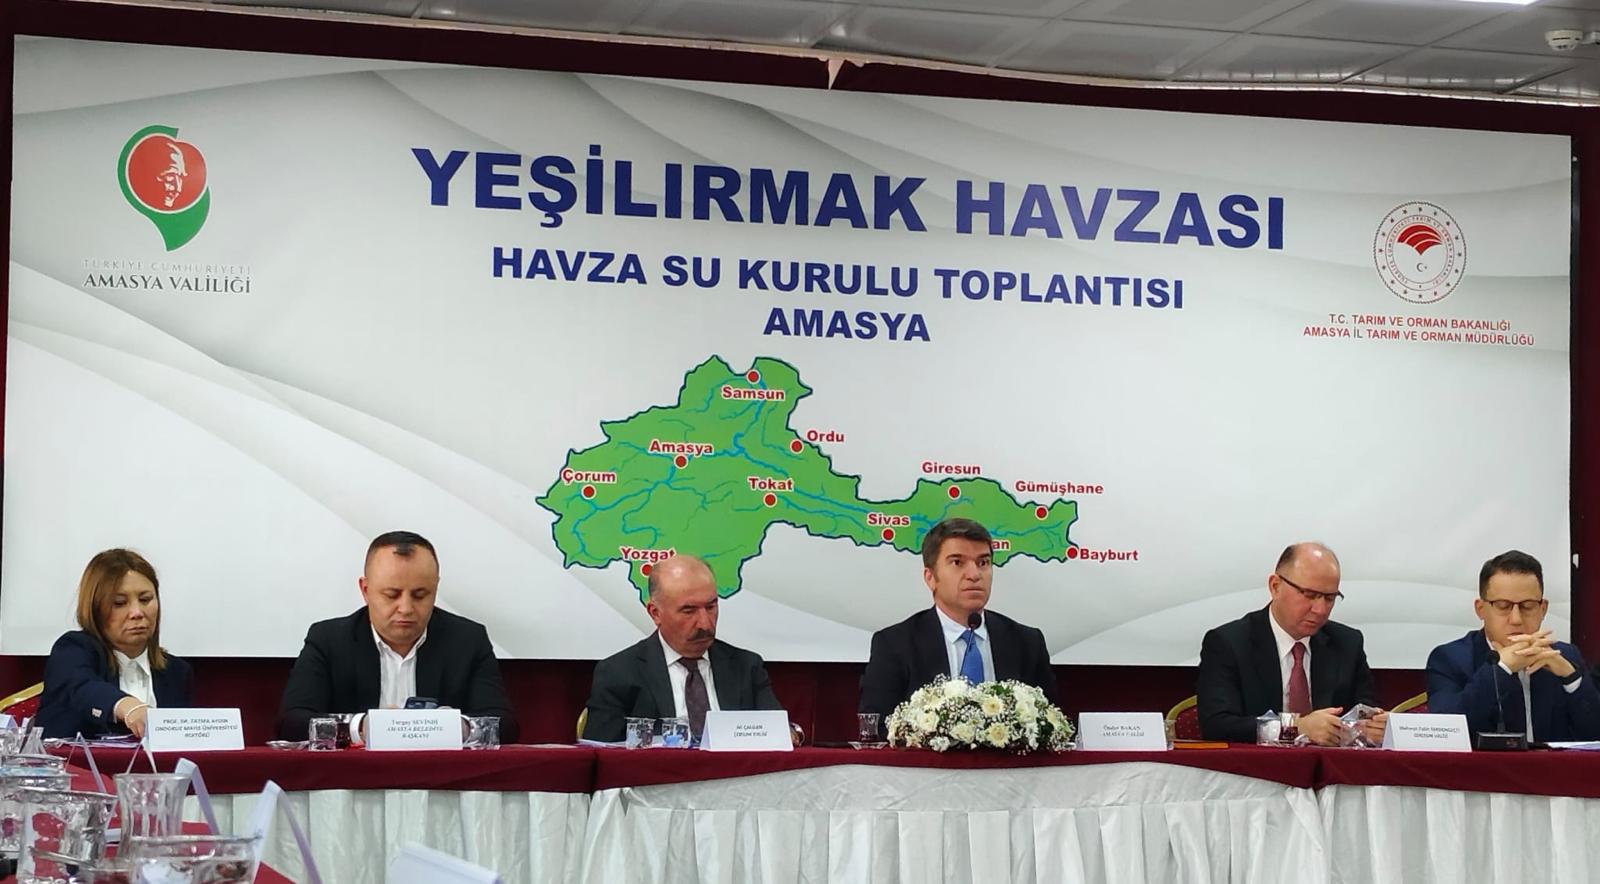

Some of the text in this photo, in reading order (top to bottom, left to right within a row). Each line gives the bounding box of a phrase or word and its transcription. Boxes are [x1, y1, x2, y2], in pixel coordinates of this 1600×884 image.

[411, 144, 1285, 251] YEŞİLIRMAK HAVZASI
[84, 273, 250, 293] AMASYA VALİLİĞİ
[493, 247, 1184, 309] HAVZA SU KURULU TOPLANTISI
[763, 307, 931, 342] AMASYA
[1329, 314, 1511, 331] T.C. TARIM VE ORMAN BAKANLIĞI
[1303, 326, 1535, 346] AMASYA İL TARIM VE ORMAN MÜDÜRLÜĞÜ
[722, 386, 785, 400] Samsun
[807, 430, 845, 443] Ordu
[650, 440, 713, 456] Amasya
[922, 462, 981, 475] Giresun
[562, 469, 616, 485] Çorum
[749, 478, 793, 491] Tokat
[1015, 480, 1104, 496] Gümüşhane
[868, 513, 910, 526] Sivas
[621, 548, 675, 562] Yozgat
[1080, 549, 1139, 563] Bayburt
